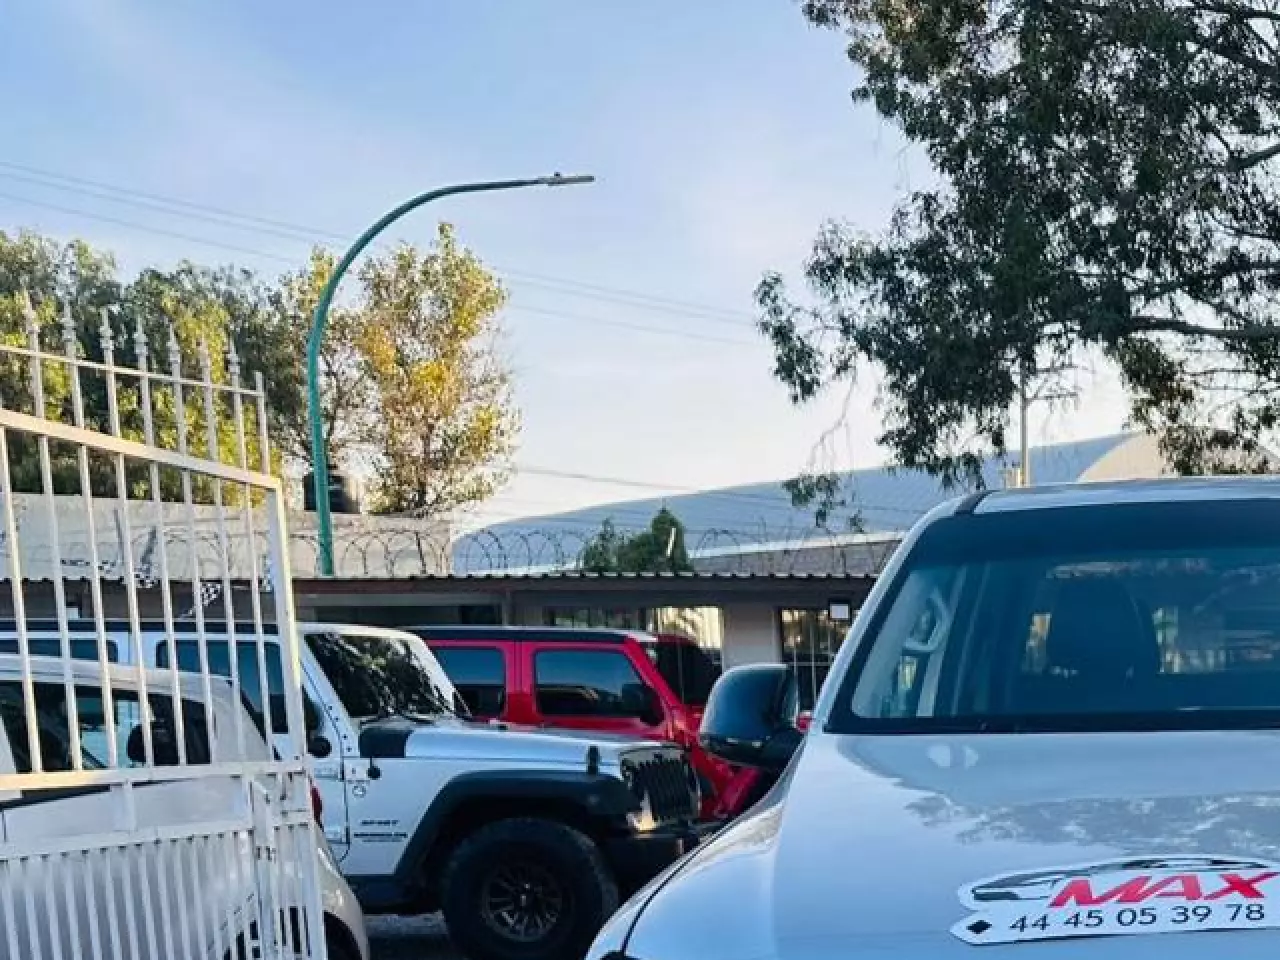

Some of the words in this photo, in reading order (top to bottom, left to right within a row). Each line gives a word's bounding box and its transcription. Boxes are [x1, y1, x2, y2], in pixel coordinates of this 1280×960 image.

[1049, 871, 1280, 908] MAX
[1009, 914, 1050, 932] 44
[1063, 910, 1103, 928] 45
[1116, 907, 1157, 926] 05
[1170, 905, 1212, 923] 39
[1225, 903, 1265, 921] 78
